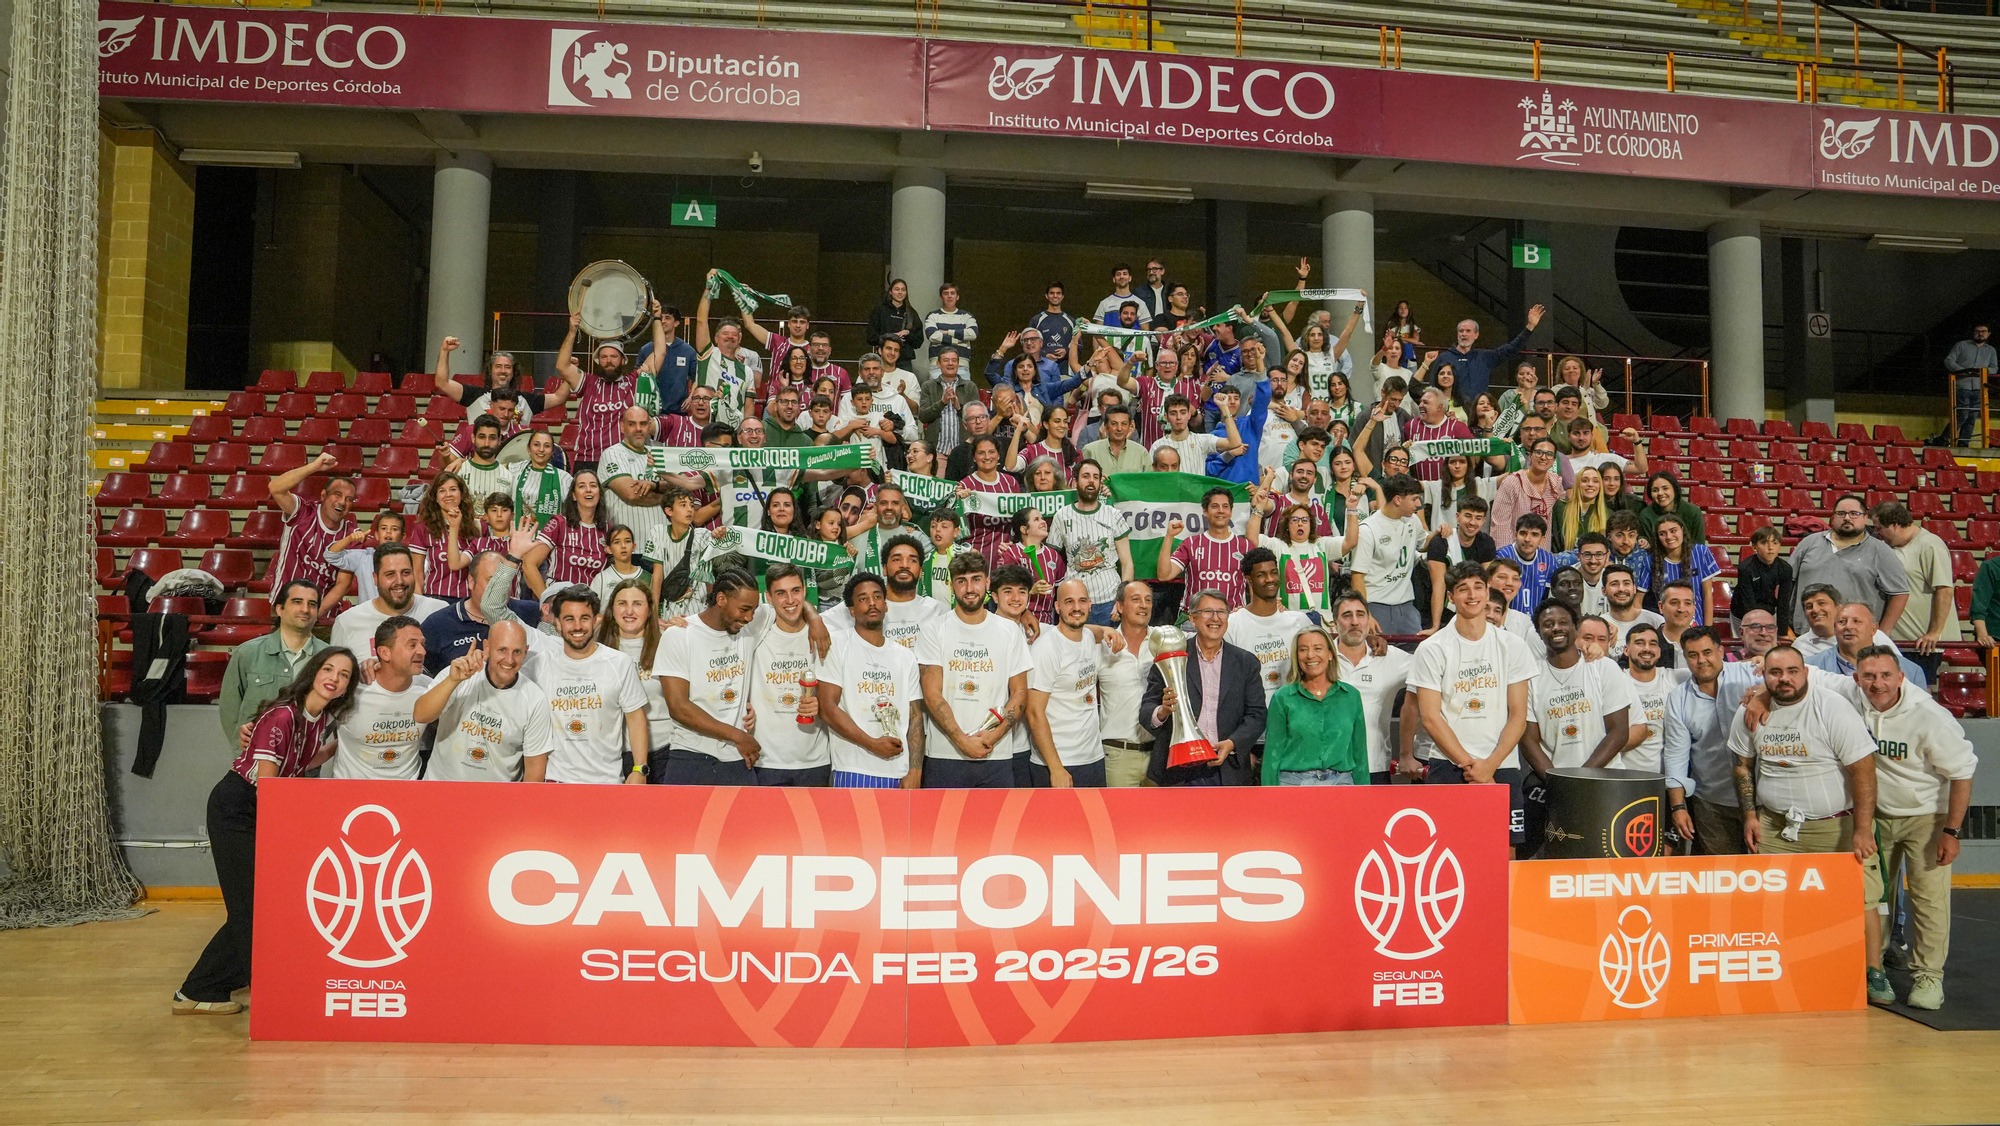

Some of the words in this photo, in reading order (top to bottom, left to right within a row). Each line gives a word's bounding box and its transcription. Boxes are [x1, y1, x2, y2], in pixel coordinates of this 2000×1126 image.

[151, 17, 406, 70] IMDECO
[647, 50, 800, 79] Diputación
[144, 72, 224, 90] Municipal
[229, 75, 250, 88] de
[255, 76, 329, 93] Deportes
[333, 79, 402, 94] Córdoba
[1071, 55, 1336, 120] IMDECO
[646, 79, 680, 101] de
[689, 80, 801, 106] Córdoba
[989, 112, 1061, 130] Instituto
[1065, 116, 1150, 137] Municipal
[1154, 122, 1177, 137] de
[1181, 123, 1259, 142] Deportes
[1263, 129, 1334, 147] Córdoba
[1583, 107, 1699, 135] AYUNTAMIENTO
[1583, 133, 1604, 154] DE
[1607, 133, 1683, 160] CÓRDOBA
[1822, 169, 1881, 187] Instituto
[1884, 174, 1956, 196] Municipal
[1959, 179, 1978, 193] de
[684, 200, 704, 222] A
[1524, 246, 1542, 265] B
[1063, 518, 1073, 534] 14
[569, 556, 602, 569] coto
[1199, 570, 1231, 582] coto
[885, 624, 921, 639] CORDOBA
[454, 636, 476, 648] coto
[1254, 638, 1286, 653] CORDOBA
[954, 647, 989, 659] CORDOBA
[771, 657, 809, 671] CORDOBA
[949, 659, 994, 673] PRIMERA
[1458, 662, 1493, 680] CORDOBA
[556, 682, 597, 697] CORDOBA
[1454, 673, 1498, 694] PRIMERA
[551, 694, 603, 711] PRIMERA
[1549, 689, 1585, 706] CORDOBA
[1547, 699, 1592, 720] PRIMERA
[372, 719, 416, 732] CORDOBA
[365, 727, 421, 744] PRIMERA
[1763, 731, 1801, 744] CORDOBA
[1759, 743, 1808, 757] PRIMERA
[488, 850, 1305, 931] CAMPEONES
[1550, 867, 1788, 898] BIENVENIDOS
[1799, 868, 1825, 892] A
[1688, 932, 1781, 947] PRIMERA
[580, 948, 861, 985] SEGUNDA
[873, 952, 979, 985] FEB
[994, 945, 1220, 984] 2025/26
[1689, 949, 1783, 984] FEB
[1373, 970, 1444, 981] SEGUNDA
[325, 979, 406, 991] SEGUNDA
[1373, 982, 1445, 1007] FEB
[325, 993, 407, 1018] FEB
